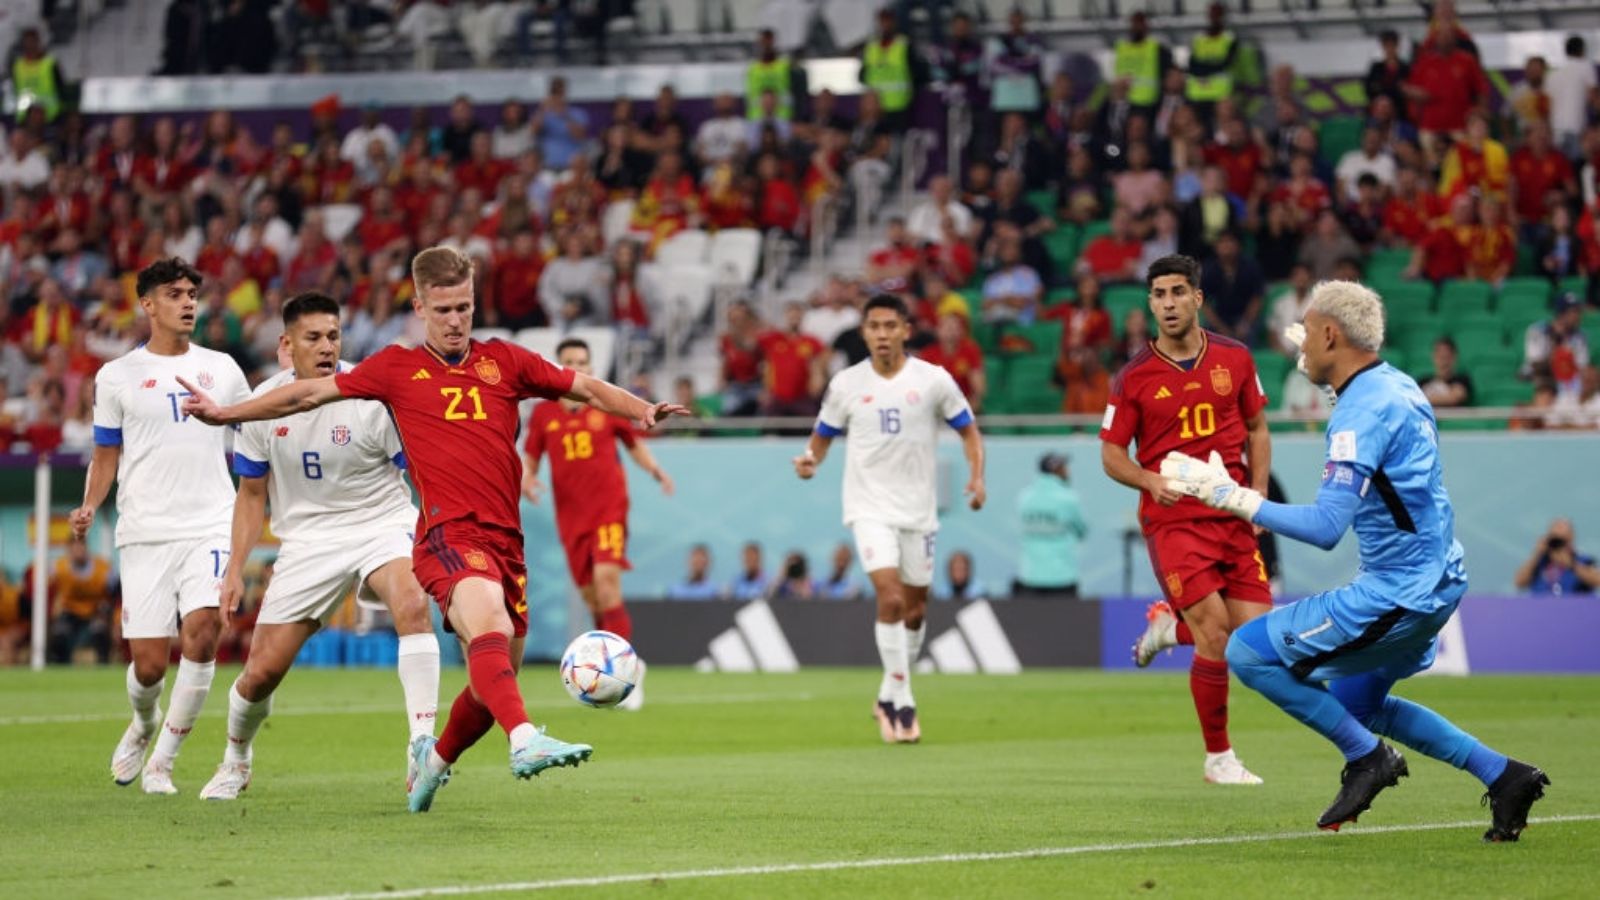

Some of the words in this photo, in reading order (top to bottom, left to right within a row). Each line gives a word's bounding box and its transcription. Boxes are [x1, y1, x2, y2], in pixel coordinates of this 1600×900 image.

[440, 386, 488, 420] 21
[879, 408, 902, 434] 16
[1178, 402, 1216, 439] 10
[562, 430, 593, 461] 18
[302, 451, 323, 480] 6
[1298, 617, 1332, 640] 1
